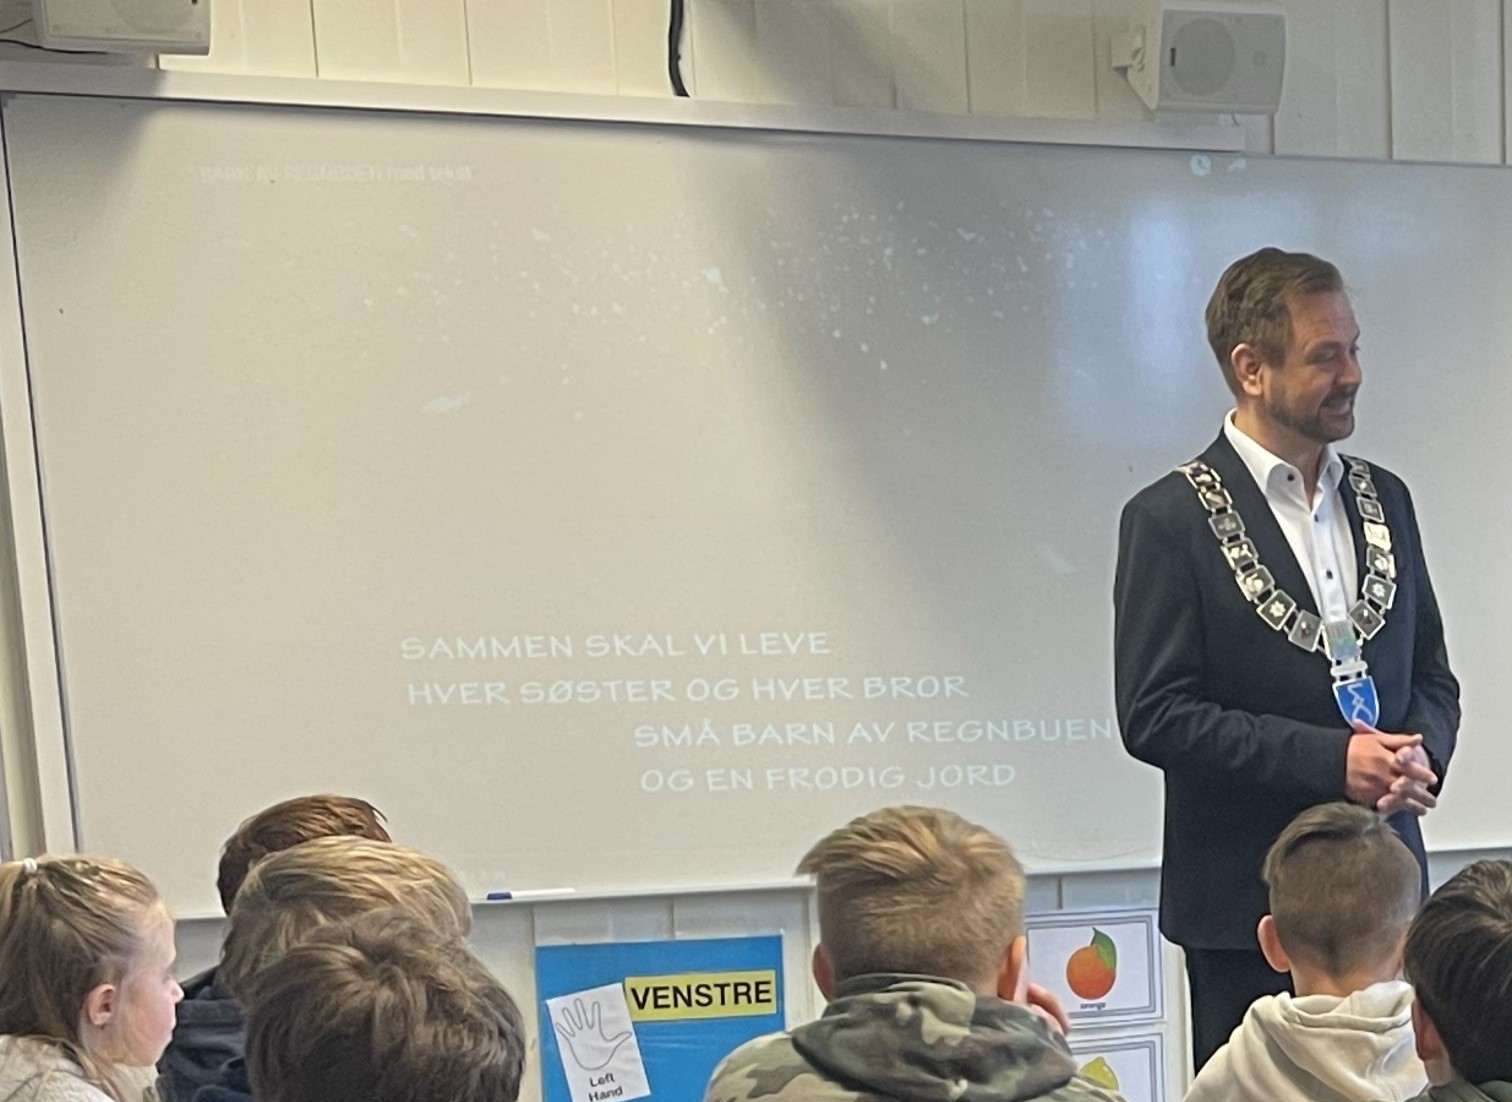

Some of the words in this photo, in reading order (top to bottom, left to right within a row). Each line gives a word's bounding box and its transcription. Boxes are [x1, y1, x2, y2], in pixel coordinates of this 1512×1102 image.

[400, 635, 573, 660] SAMMEN
[585, 633, 684, 658] SKAL
[693, 632, 728, 656] VI
[739, 631, 833, 655] LEVE
[407, 681, 510, 705] HVER
[519, 679, 677, 704] SØSTER
[686, 678, 740, 701] OG
[751, 677, 854, 700] HVER
[863, 675, 969, 699] BROR
[634, 716, 721, 748] SMÅ
[732, 721, 835, 747] BARN
[845, 721, 896, 745] AV
[906, 717, 1112, 743] REGNBUEN
[640, 768, 694, 792] OG
[705, 768, 754, 791] EN
[765, 766, 905, 791] FRODIG
[916, 763, 1017, 789] JORD
[630, 980, 773, 1011] VENSTRE
[589, 1072, 616, 1089] Left
